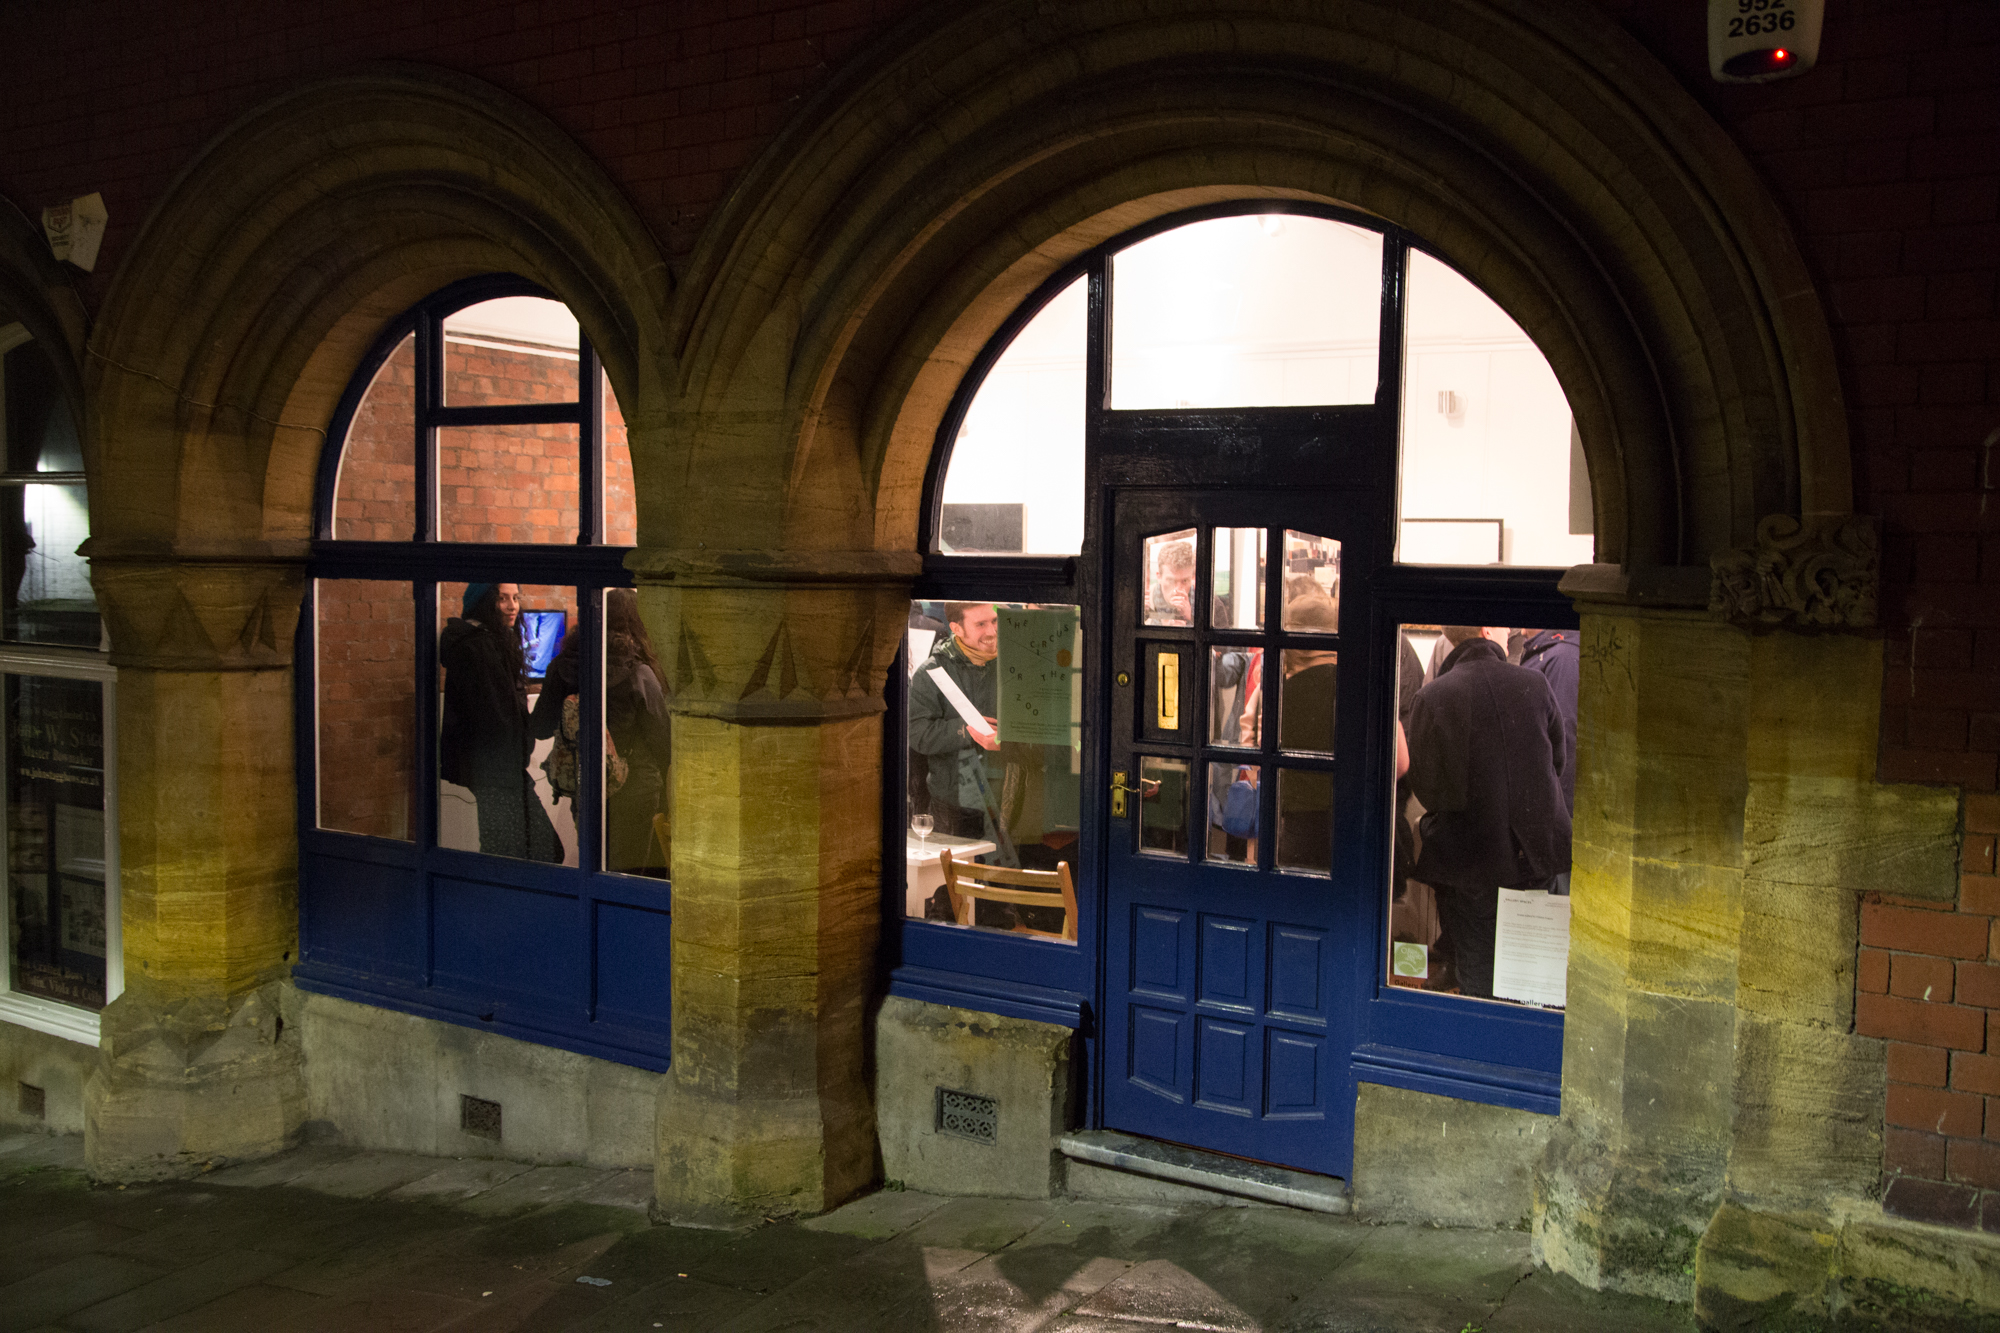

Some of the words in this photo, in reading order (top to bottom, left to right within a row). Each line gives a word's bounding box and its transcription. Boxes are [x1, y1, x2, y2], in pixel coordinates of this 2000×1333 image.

[1728, 10, 1795, 38] 2636
[1006, 617, 1029, 629] THE
[1029, 623, 1069, 656] CIRCUS
[1009, 666, 1023, 681] OR
[1040, 670, 1066, 682] THE
[1016, 693, 1039, 717] ZOO
